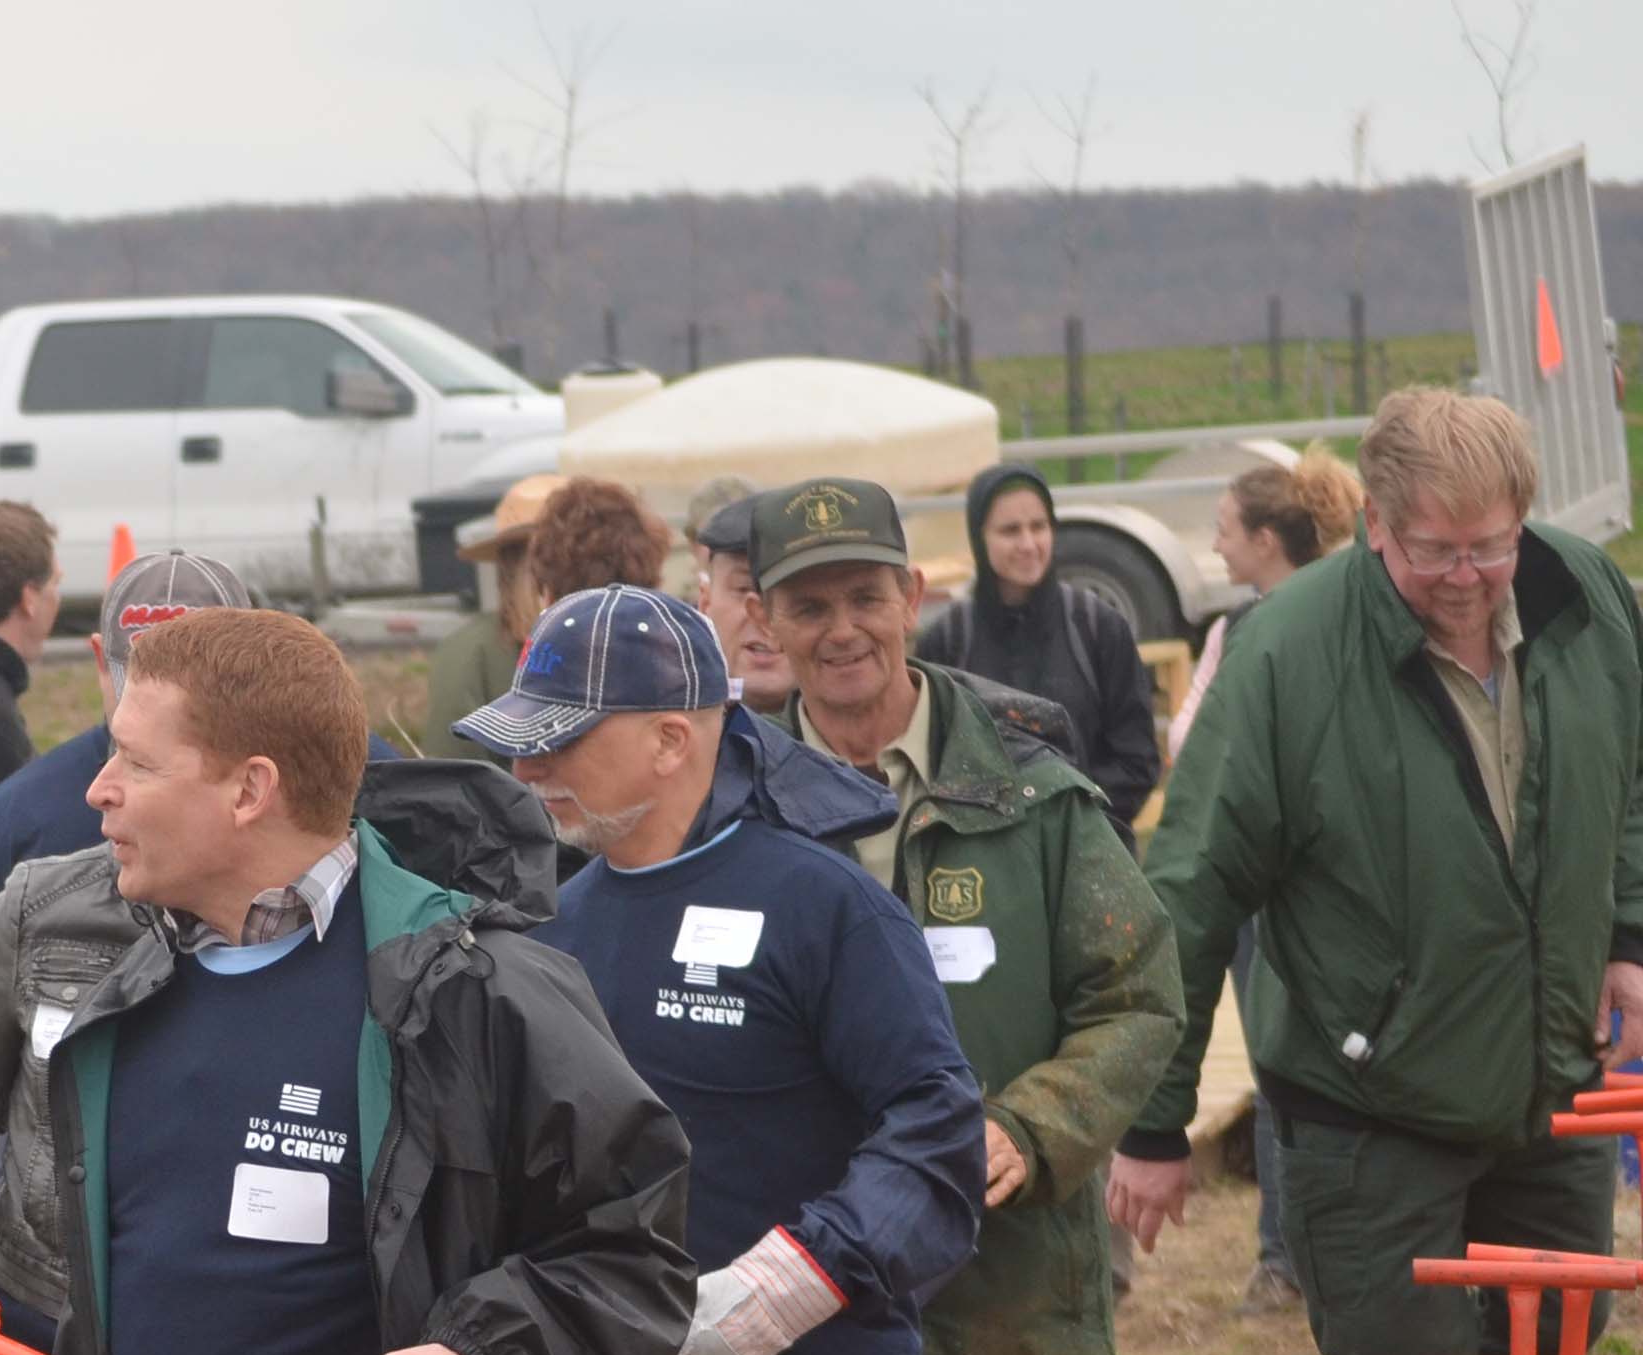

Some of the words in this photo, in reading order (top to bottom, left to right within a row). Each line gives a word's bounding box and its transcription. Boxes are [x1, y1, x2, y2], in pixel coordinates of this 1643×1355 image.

[655, 1000, 684, 1020] DO
[689, 1004, 745, 1027] CREW
[680, 992, 746, 1009] AIRWAYS
[271, 1120, 348, 1146] AIRWAYS
[244, 1131, 276, 1152] DO
[280, 1137, 346, 1164] CREW
